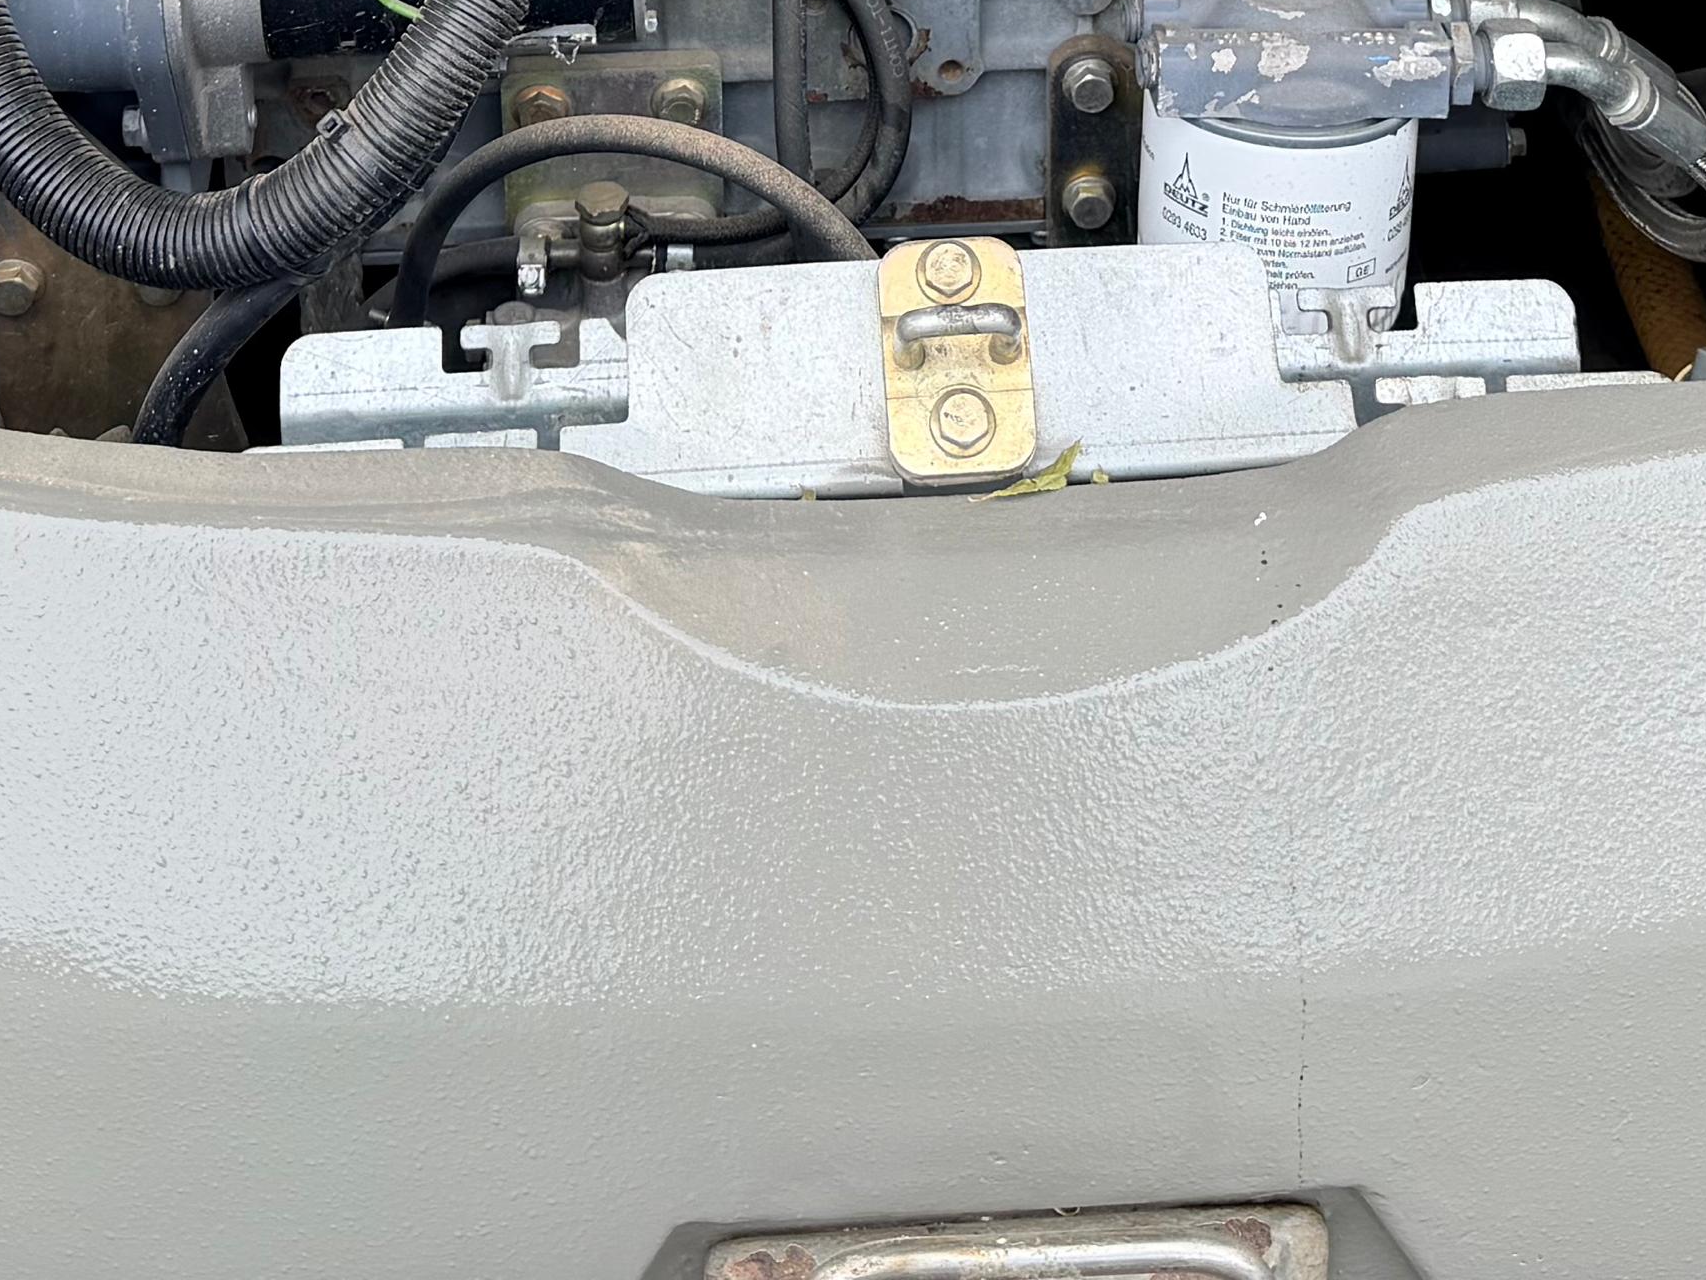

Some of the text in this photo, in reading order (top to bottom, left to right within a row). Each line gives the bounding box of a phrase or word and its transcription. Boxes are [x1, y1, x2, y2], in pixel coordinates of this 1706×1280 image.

[1163, 182, 1209, 214] DEUTZ
[1222, 192, 1241, 206] Nur
[1243, 197, 1259, 211] für
[1222, 203, 1311, 227] Einbau von Hand
[1270, 236, 1282, 248] 10
[1283, 237, 1298, 248] bis
[1299, 237, 1311, 248] 12
